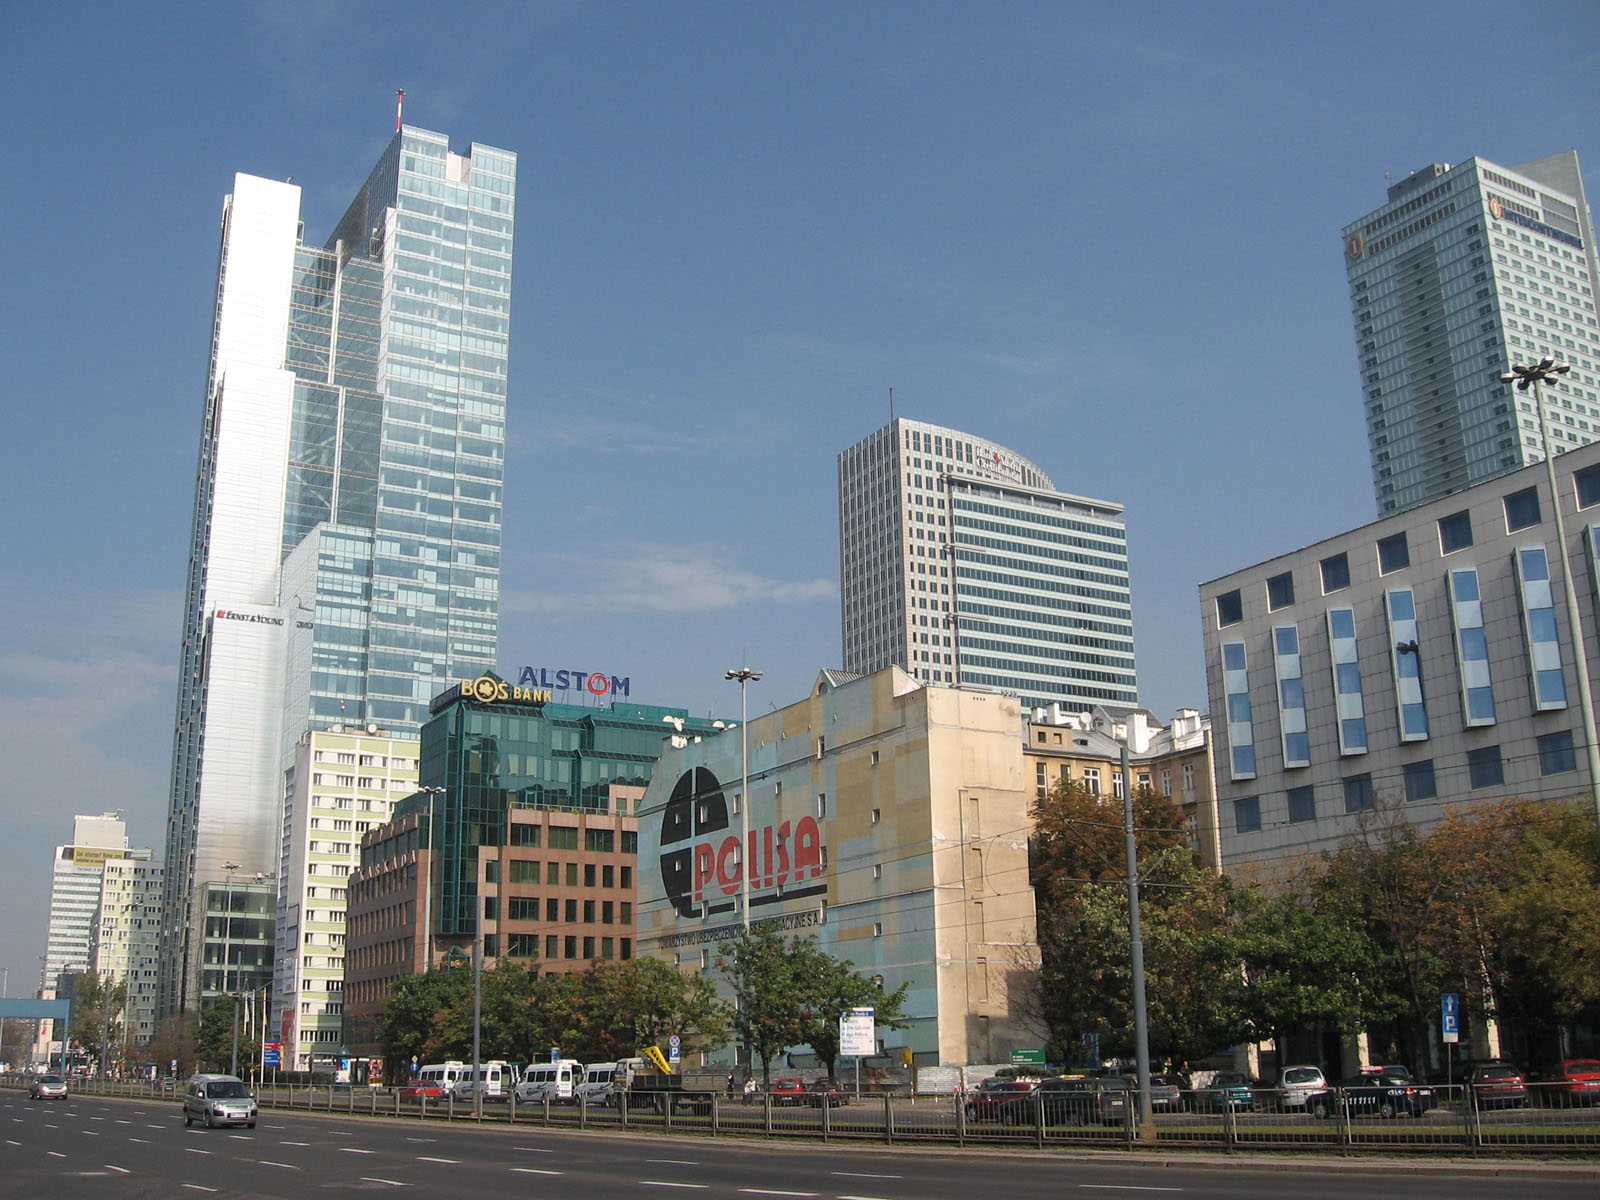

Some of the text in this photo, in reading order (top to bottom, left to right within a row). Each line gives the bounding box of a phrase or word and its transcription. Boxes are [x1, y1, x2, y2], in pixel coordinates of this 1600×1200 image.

[461, 676, 552, 702] BOŚ BANK
[518, 666, 630, 697] ALSTOM
[695, 816, 821, 901] POLISA
[1445, 1015, 1457, 1031] P
[672, 1047, 678, 1056] P
